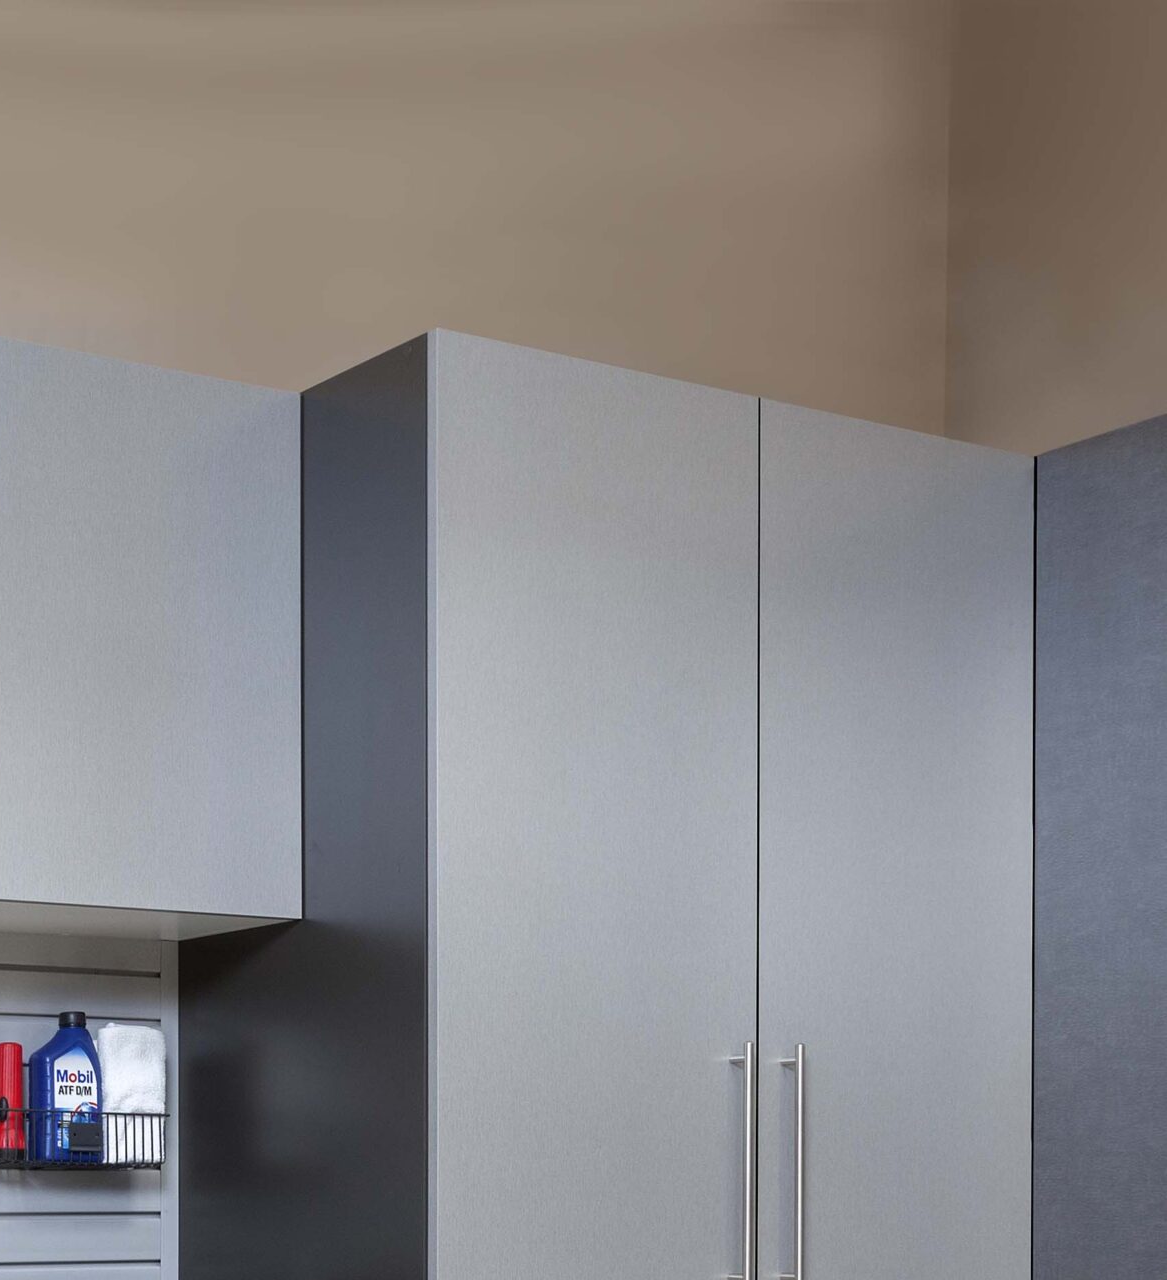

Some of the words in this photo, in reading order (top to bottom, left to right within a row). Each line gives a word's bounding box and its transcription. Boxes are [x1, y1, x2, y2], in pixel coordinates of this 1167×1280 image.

[56, 1069, 93, 1084] Mobil
[58, 1085, 74, 1096] ATF
[76, 1085, 92, 1097] D/M
